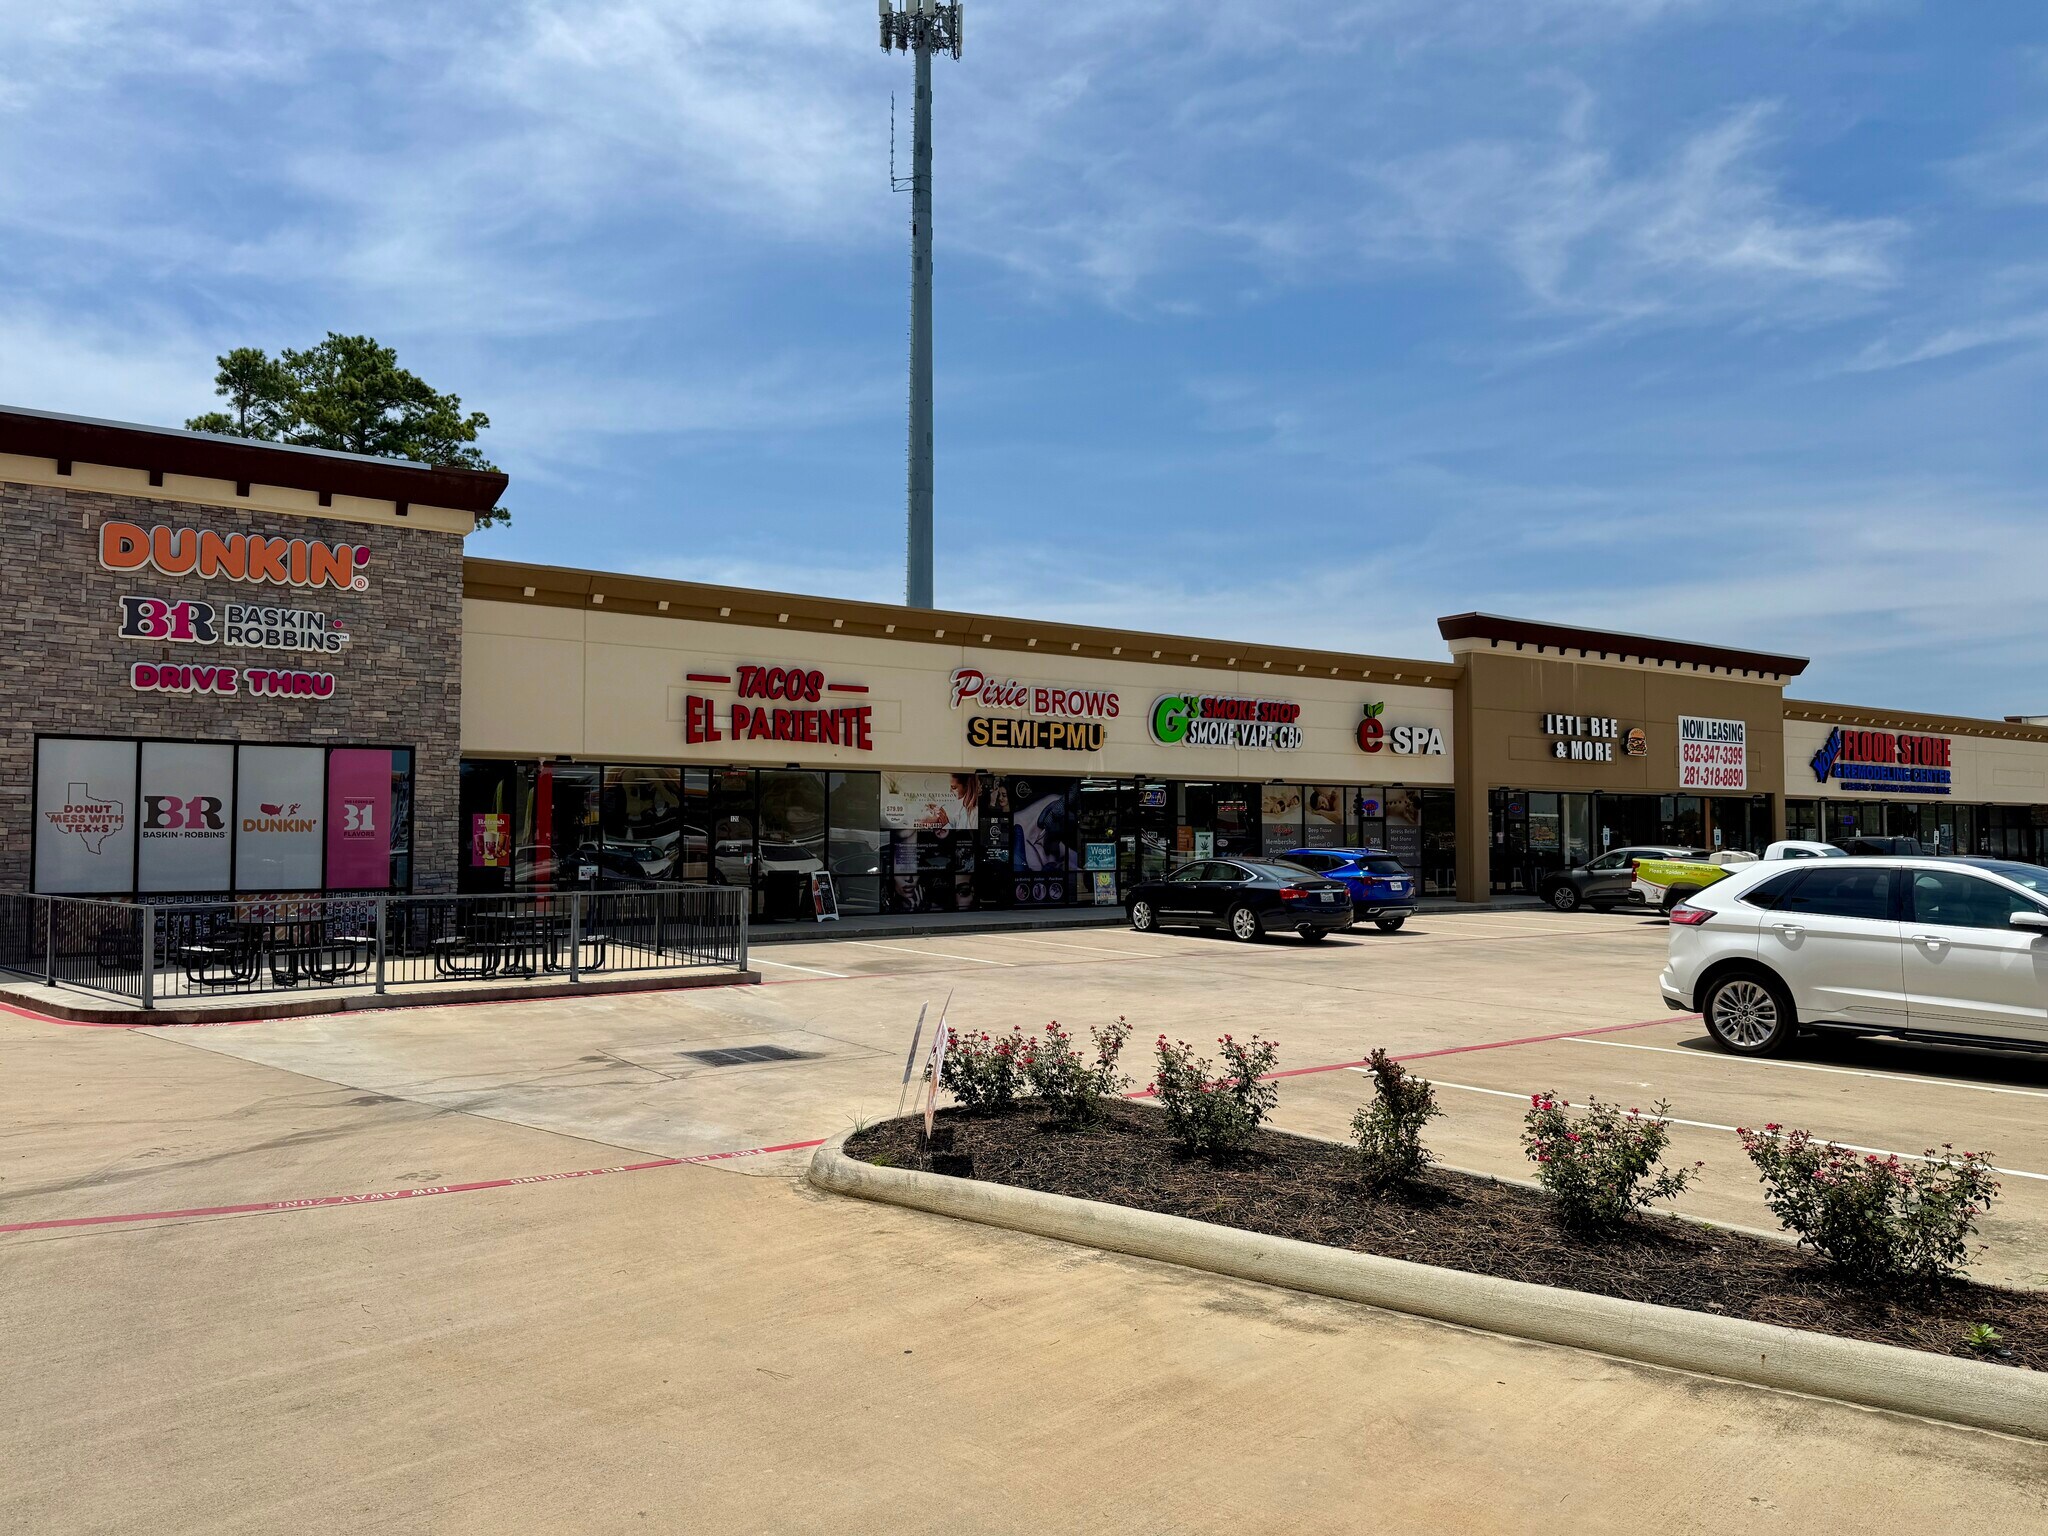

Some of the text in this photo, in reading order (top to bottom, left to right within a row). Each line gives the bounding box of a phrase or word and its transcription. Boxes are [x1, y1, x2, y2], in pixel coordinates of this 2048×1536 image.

[102, 521, 371, 589] DUNKIN'
[228, 605, 324, 631] BASKIN
[227, 625, 342, 651] ROBBINS
[134, 664, 333, 695] DRIVE THRU
[737, 665, 825, 703] TACOS
[953, 669, 1120, 718] Pixie BROWS
[686, 694, 873, 751] EL PARIENTE
[1204, 698, 1256, 721] SMOKE
[1261, 702, 1301, 723] SHOP
[971, 719, 1104, 750] SEMI-PMU
[1190, 721, 1303, 749] SMOKE VAPE CBD
[1547, 713, 1618, 738] LETI BEE
[1682, 719, 1743, 742] NOW LEASING
[1394, 726, 1446, 755] SPA
[1555, 740, 1612, 761] & MORE
[1843, 730, 1951, 767] FLOOR STORE
[1683, 743, 1743, 765] 832-347-3399
[1684, 765, 1743, 787] 281-318-8890
[1834, 763, 1951, 784] & REMODELING CENTER
[50, 814, 125, 823] MESS WITH
[64, 805, 112, 814] DONUT
[143, 796, 225, 830] BR
[344, 804, 375, 831] 31
[243, 818, 317, 833] DUNKIN'
[1091, 846, 1111, 855] Weed
[1265, 838, 1297, 846] Membership
[729, 1148, 767, 1159] FIRE
[510, 1170, 593, 1184] PARKING
[339, 1190, 400, 1203] AWAY
[411, 1185, 450, 1196] TOW
[267, 1197, 328, 1210] ZONE
